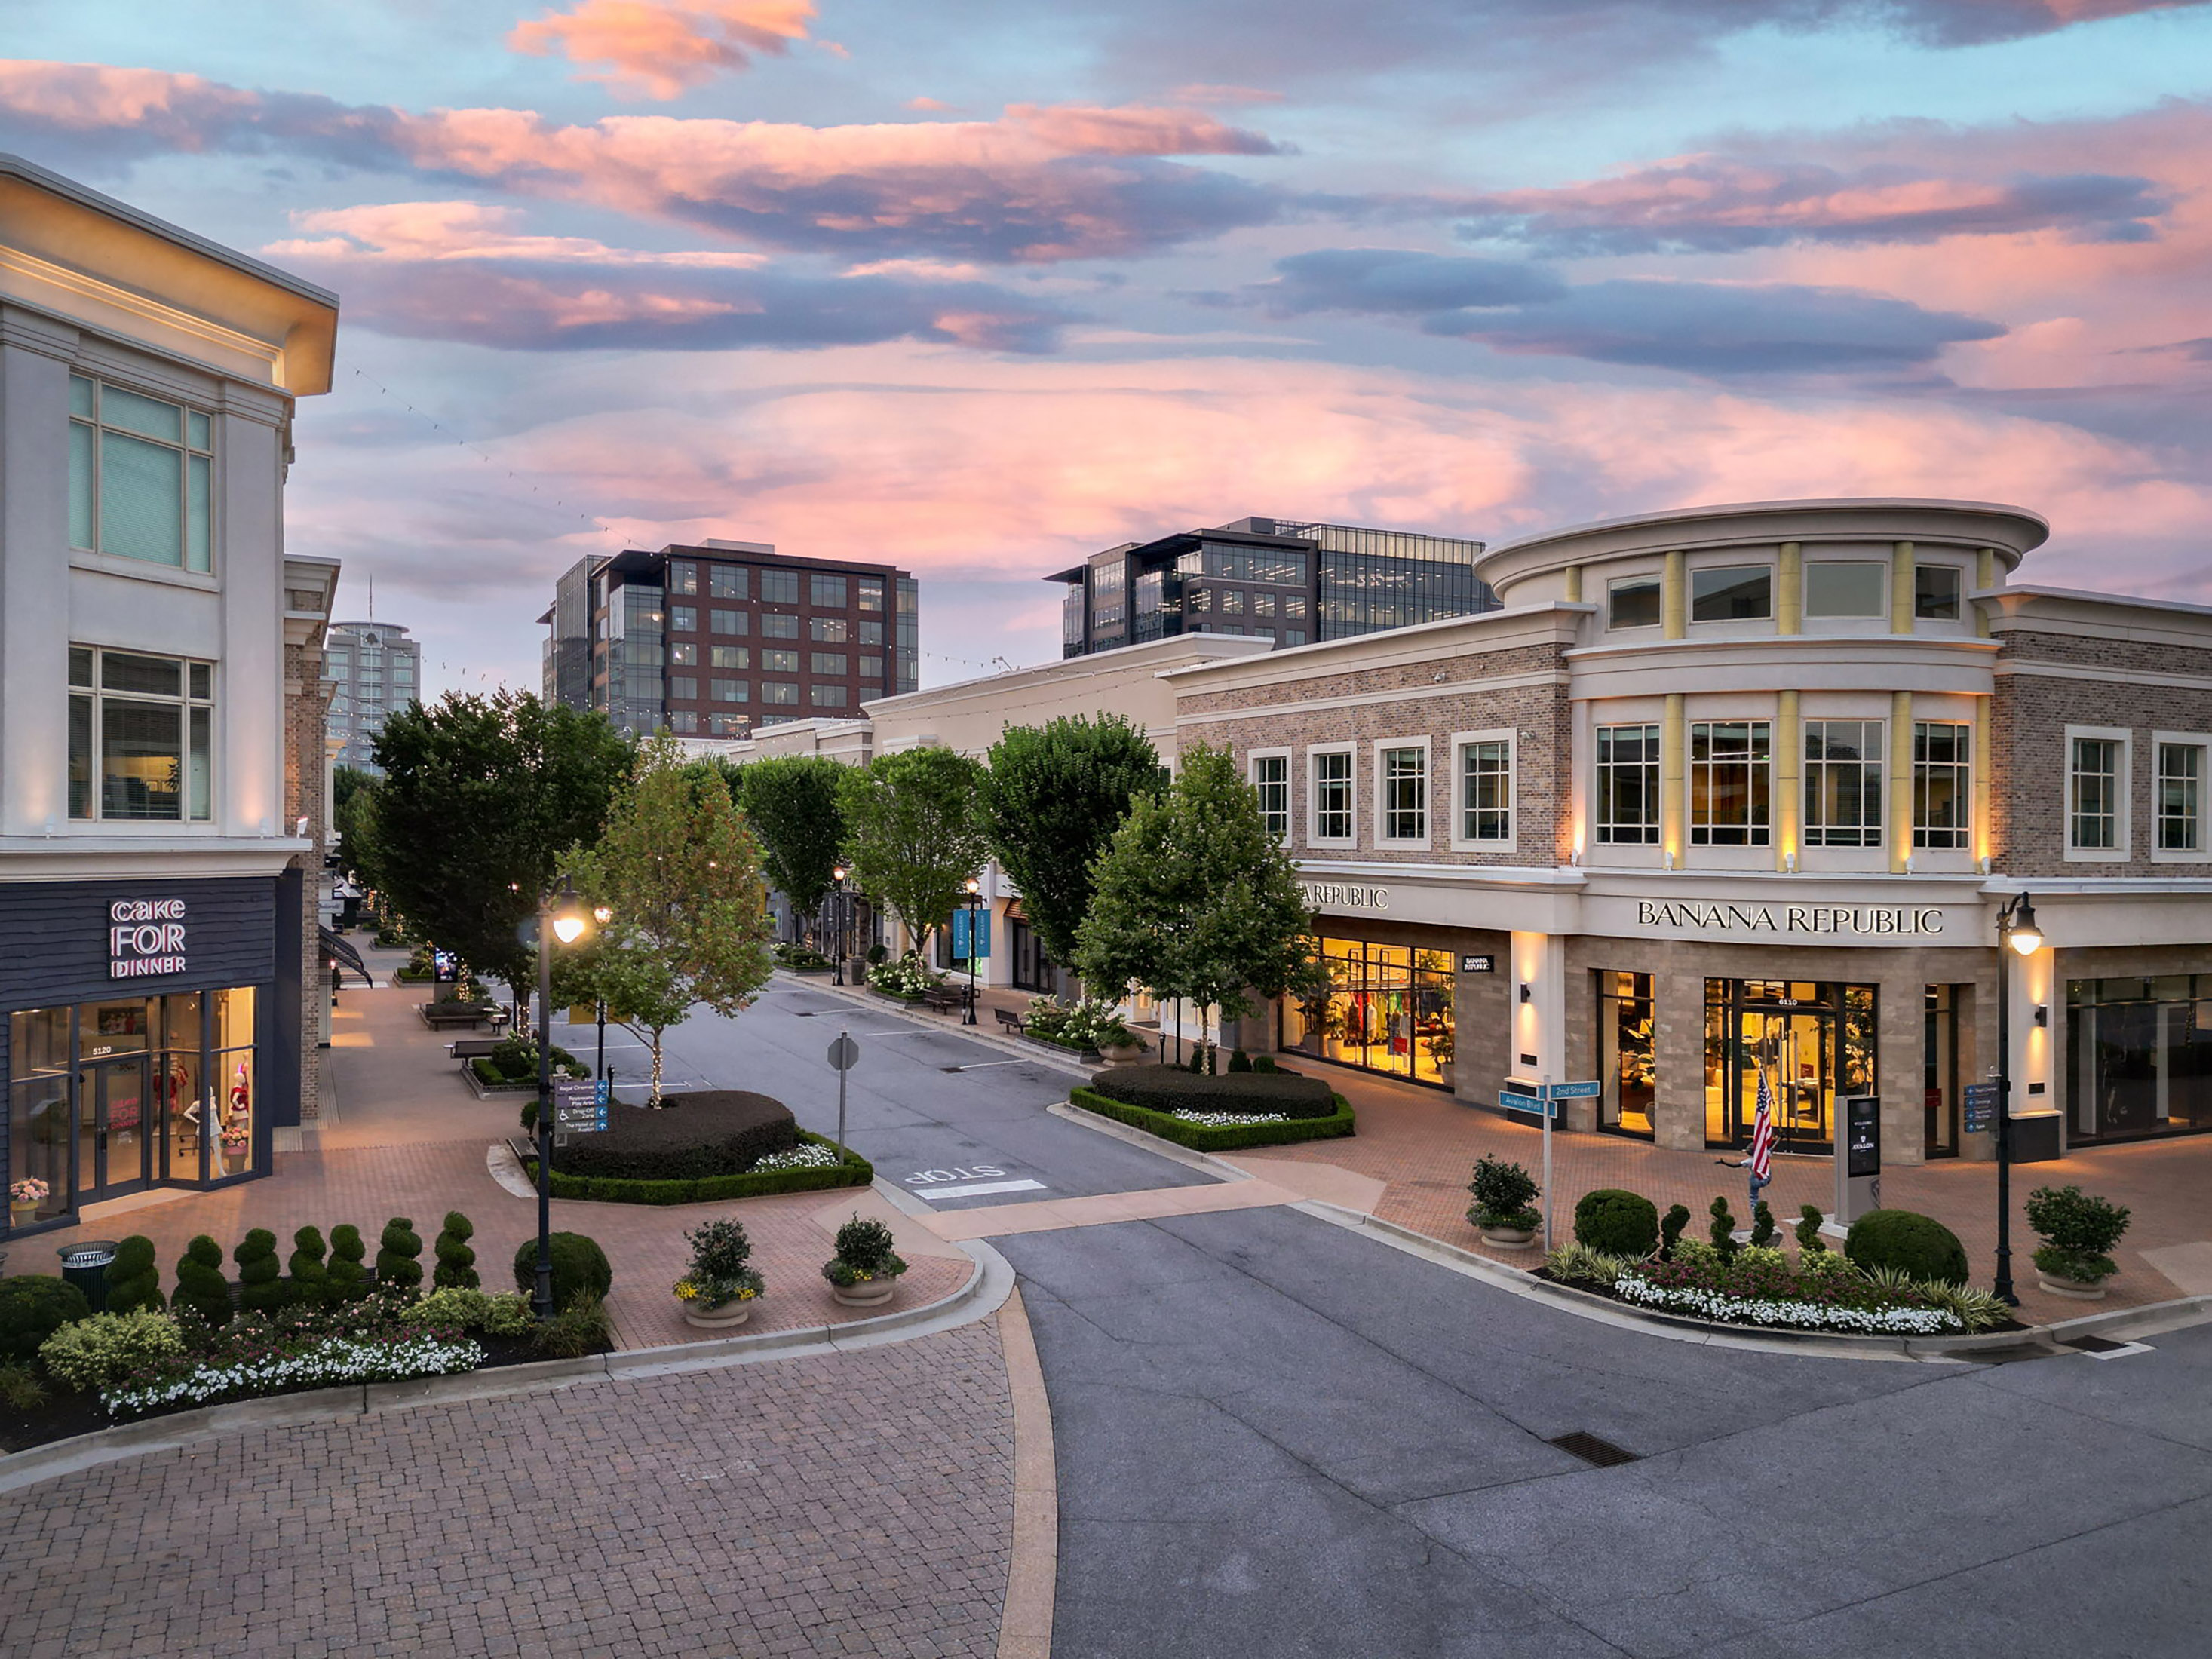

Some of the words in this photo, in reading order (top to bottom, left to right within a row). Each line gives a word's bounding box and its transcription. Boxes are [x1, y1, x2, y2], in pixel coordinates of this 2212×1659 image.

[1314, 884, 1388, 909] REPUBLIC
[1637, 900, 1778, 931] BANANA
[1787, 906, 1944, 934] REPUBLIC
[111, 924, 186, 956] FOR
[111, 956, 186, 977] DINNER
[92, 1046, 112, 1056] 5120
[1556, 1087, 1569, 1096] 2nd
[1570, 1086, 1591, 1094] Street
[1505, 1097, 1526, 1108] Avalon
[905, 1165, 1006, 1185] STOP
